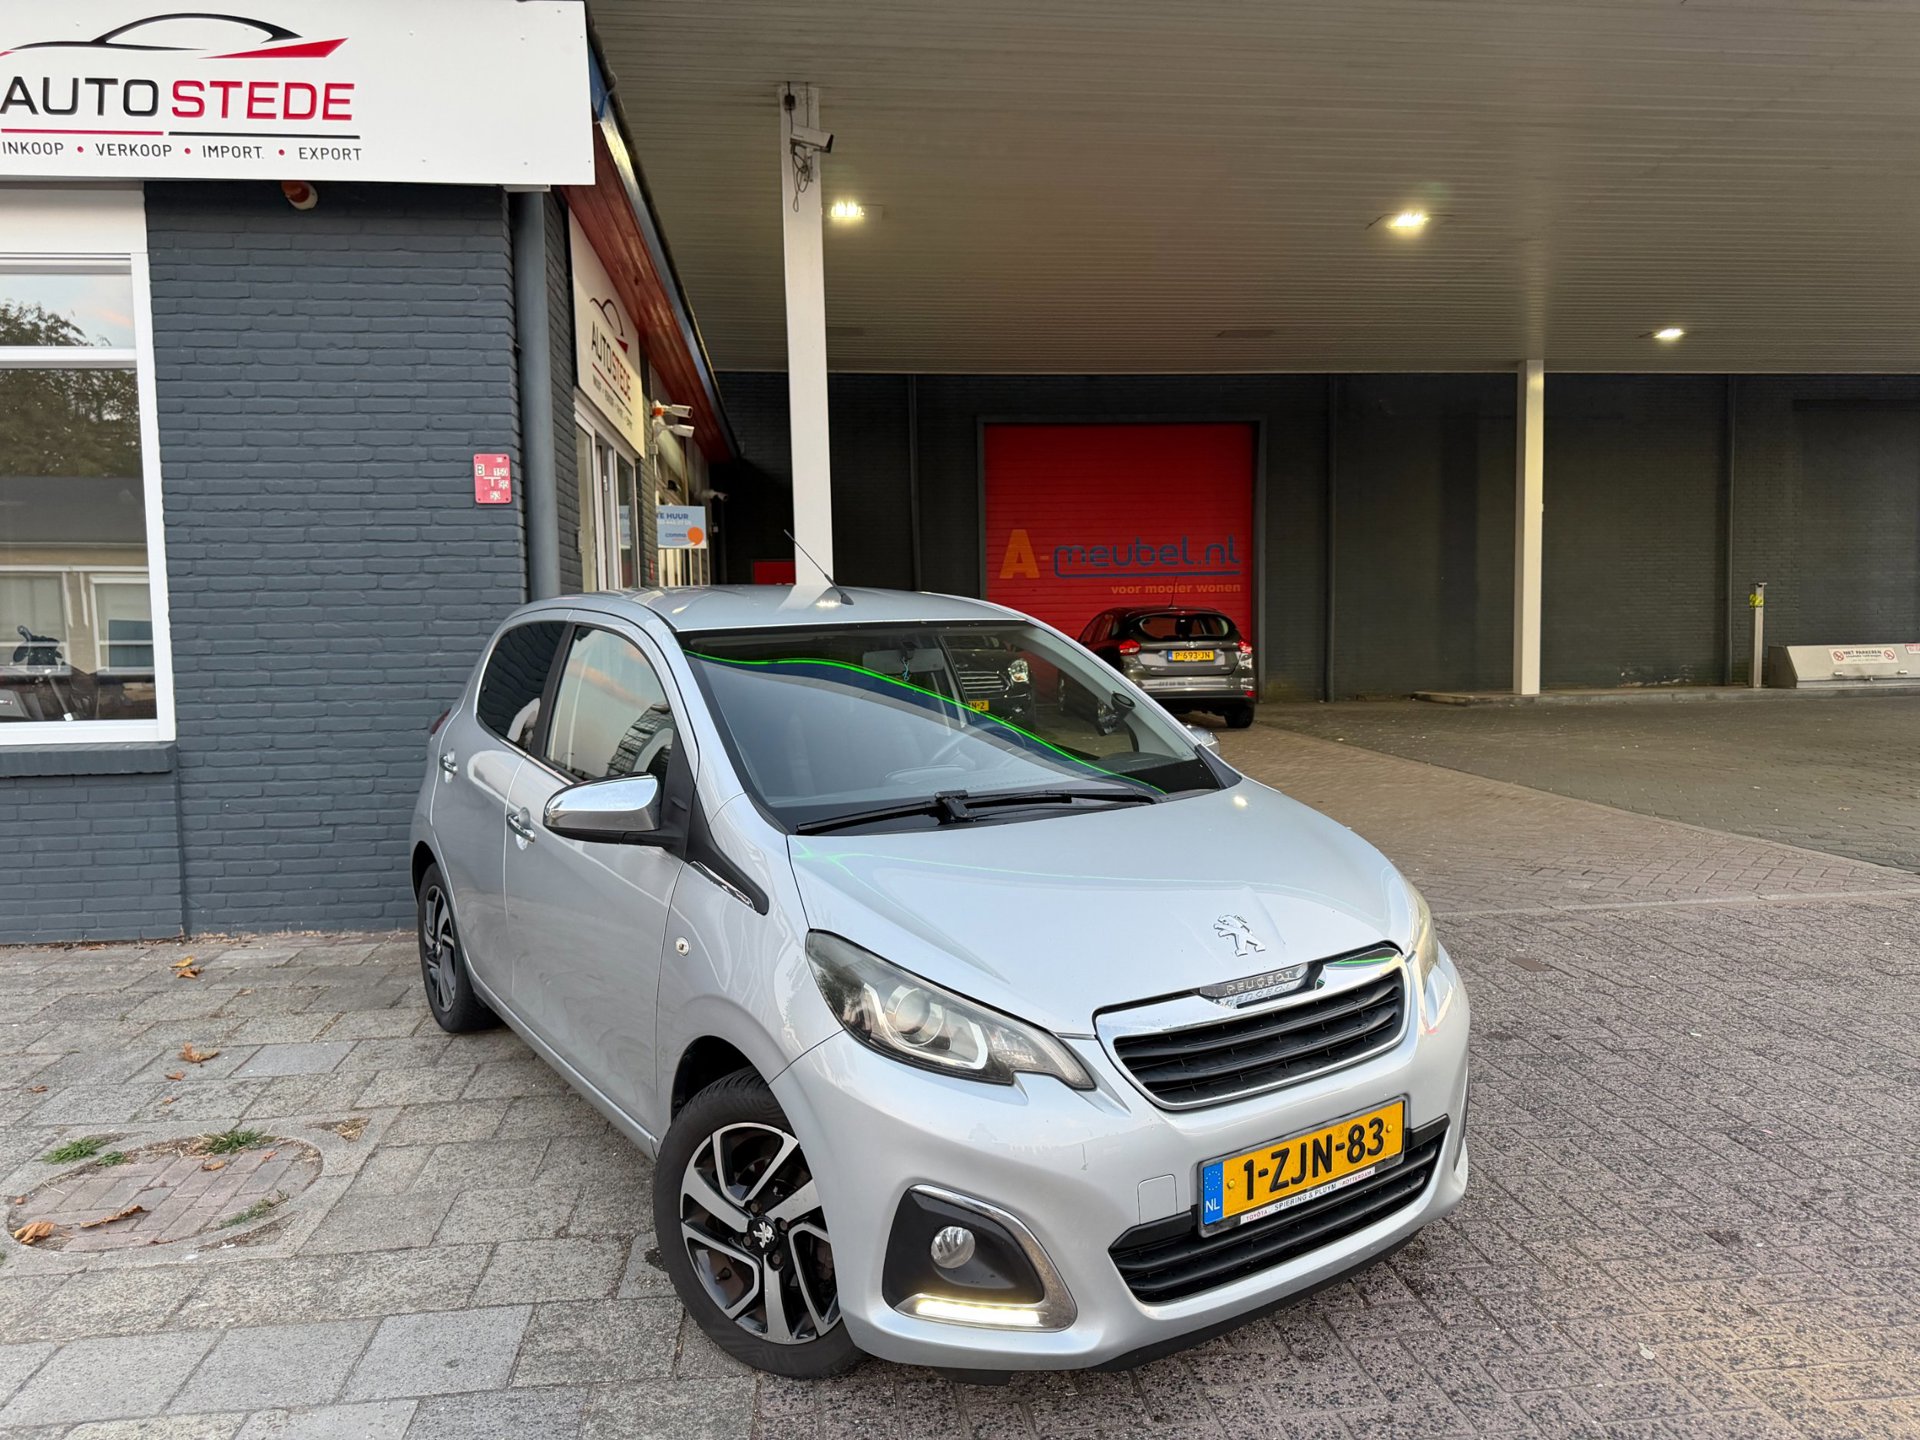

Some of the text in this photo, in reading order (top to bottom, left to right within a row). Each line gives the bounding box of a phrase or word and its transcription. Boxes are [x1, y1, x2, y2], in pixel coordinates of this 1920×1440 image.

[0, 76, 355, 121] AUTO STEDE
[2, 140, 64, 156] INKOOP
[96, 142, 173, 158] VERKOOP
[299, 146, 362, 161] EXPORT
[1111, 583, 1241, 594] voor mooier wonen
[1226, 970, 1293, 994] PEUGEOT
[1244, 1117, 1384, 1200] 1-ZJN-83
[1205, 1198, 1220, 1213] NL
[1246, 1209, 1268, 1221] TOYOTA
[1274, 1193, 1307, 1211] SPIERING
